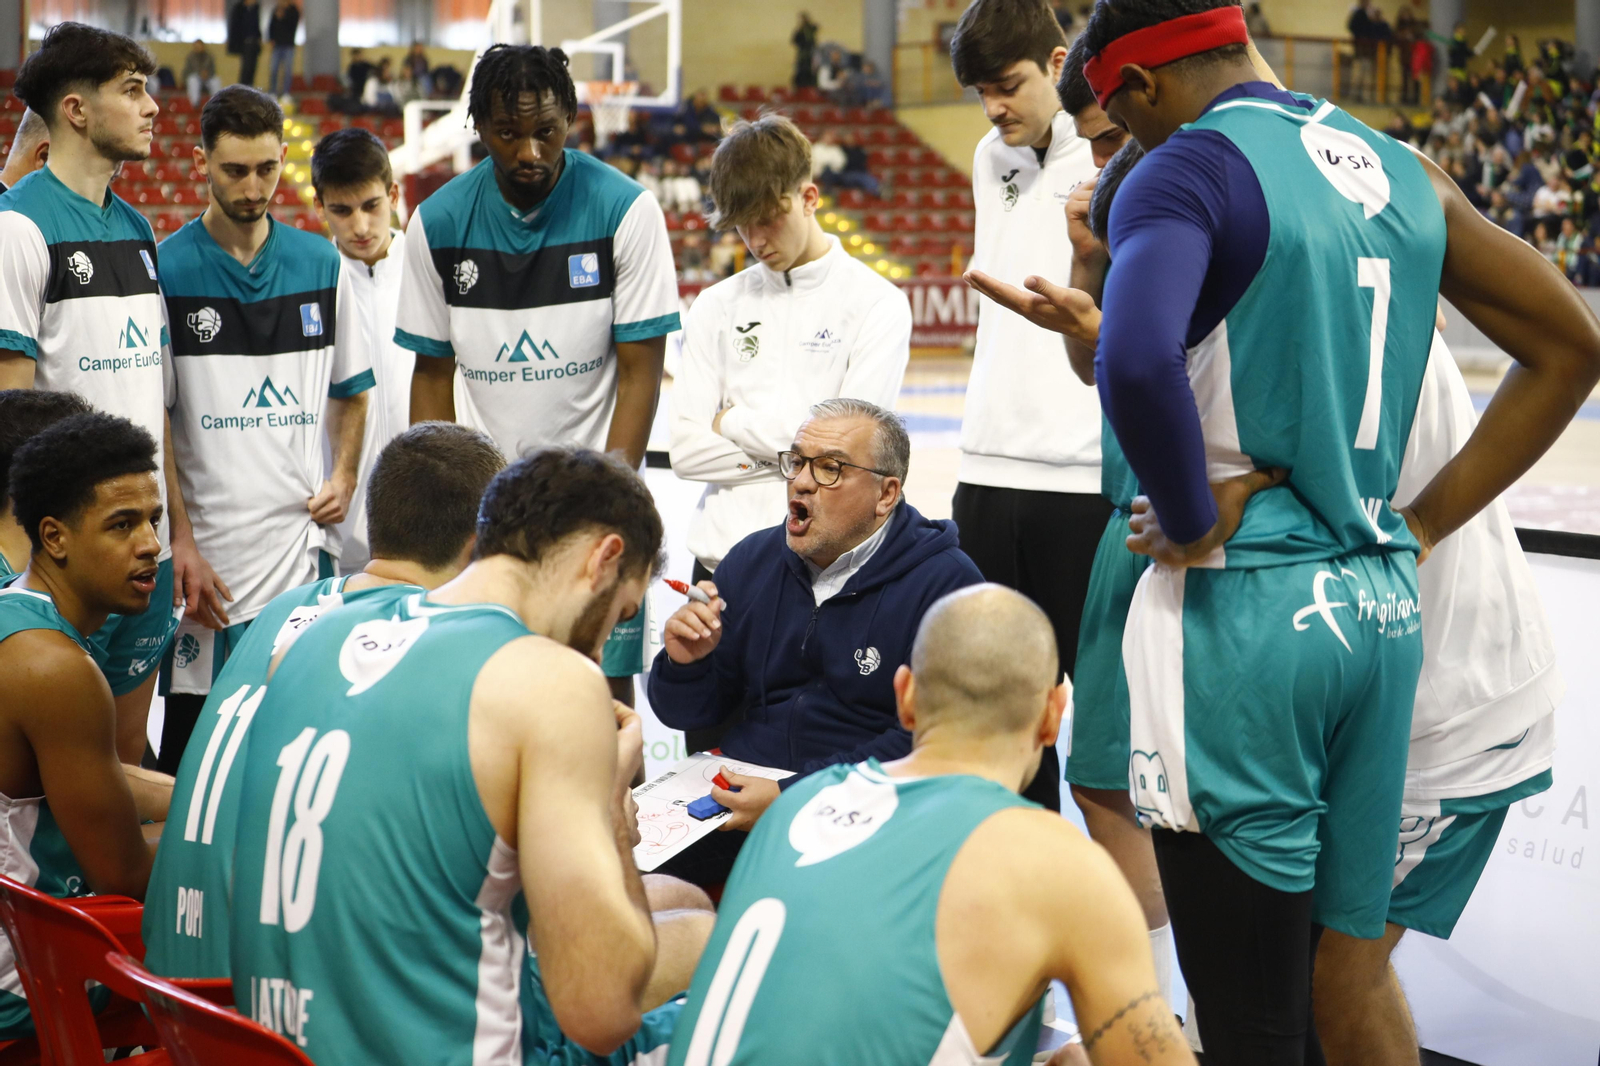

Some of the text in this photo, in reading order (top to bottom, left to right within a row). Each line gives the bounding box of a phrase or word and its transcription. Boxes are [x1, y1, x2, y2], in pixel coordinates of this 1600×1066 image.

[573, 276, 593, 285] EBA
[187, 313, 213, 342] UCB
[78, 356, 132, 373] Camper
[1354, 257, 1391, 450] 7
[460, 356, 603, 385] Camper EuroGaza
[201, 414, 263, 431] Camper
[854, 648, 871, 676] UCB
[183, 684, 267, 845] 11
[260, 727, 351, 933] 18
[1506, 837, 1584, 870] salud
